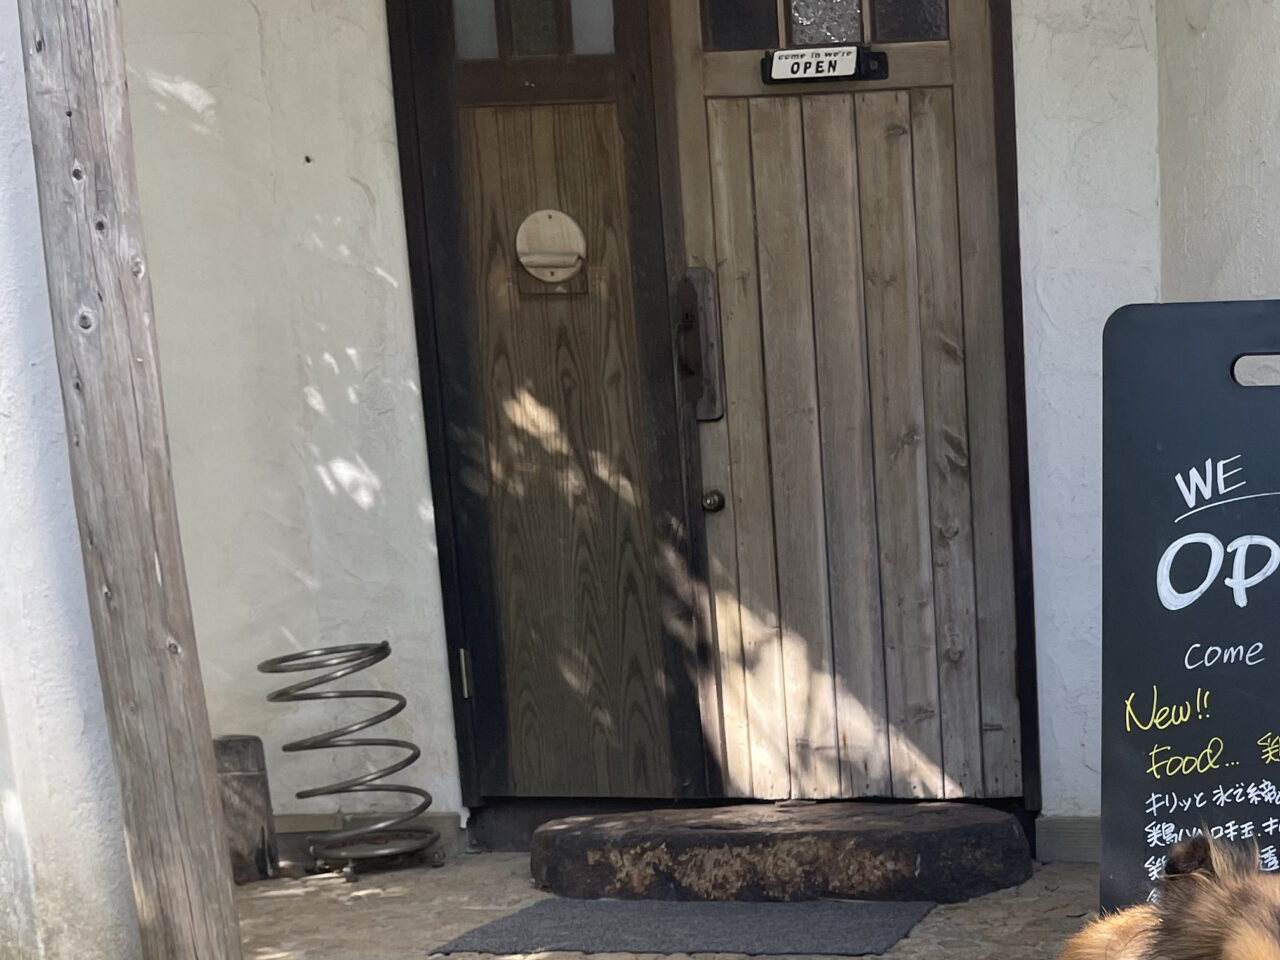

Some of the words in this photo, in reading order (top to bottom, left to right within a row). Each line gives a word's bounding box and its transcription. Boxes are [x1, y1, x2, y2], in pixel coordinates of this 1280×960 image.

[790, 60, 837, 75] OPEN
[1174, 454, 1246, 508] WE
[1184, 640, 1264, 670] come
[1124, 685, 1213, 732] New!!
